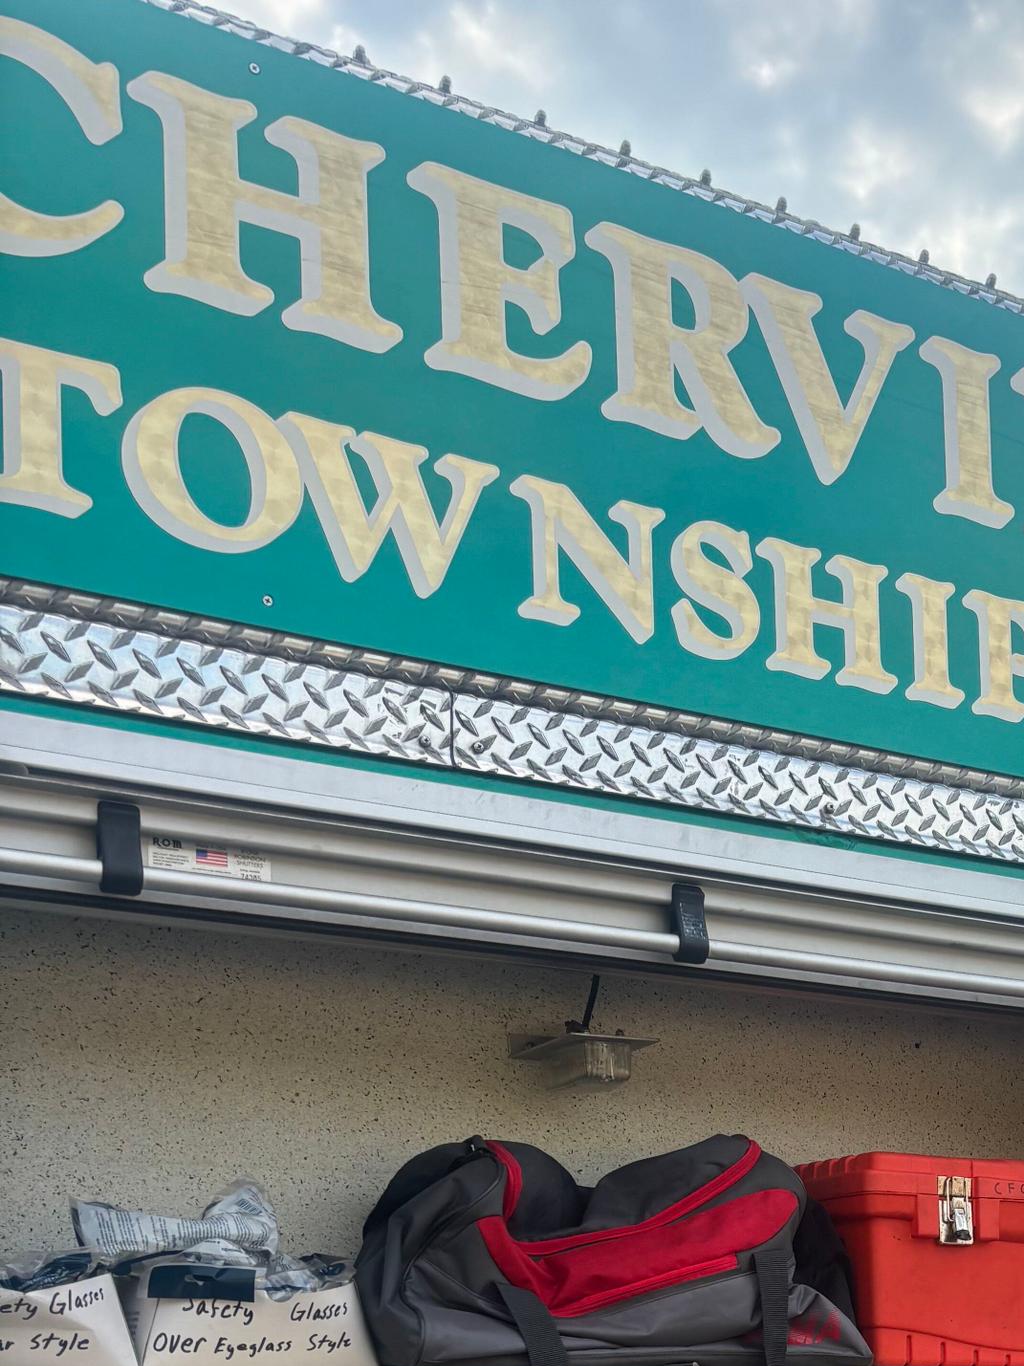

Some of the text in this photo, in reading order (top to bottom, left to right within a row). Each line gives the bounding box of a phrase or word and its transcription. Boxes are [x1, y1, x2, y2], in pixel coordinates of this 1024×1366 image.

[49, 1287, 104, 1315] Glasses
[290, 1302, 348, 1322] Glasses
[30, 1333, 90, 1357] Style
[214, 1336, 292, 1360] Eyeglass
[306, 1332, 352, 1352] Style
